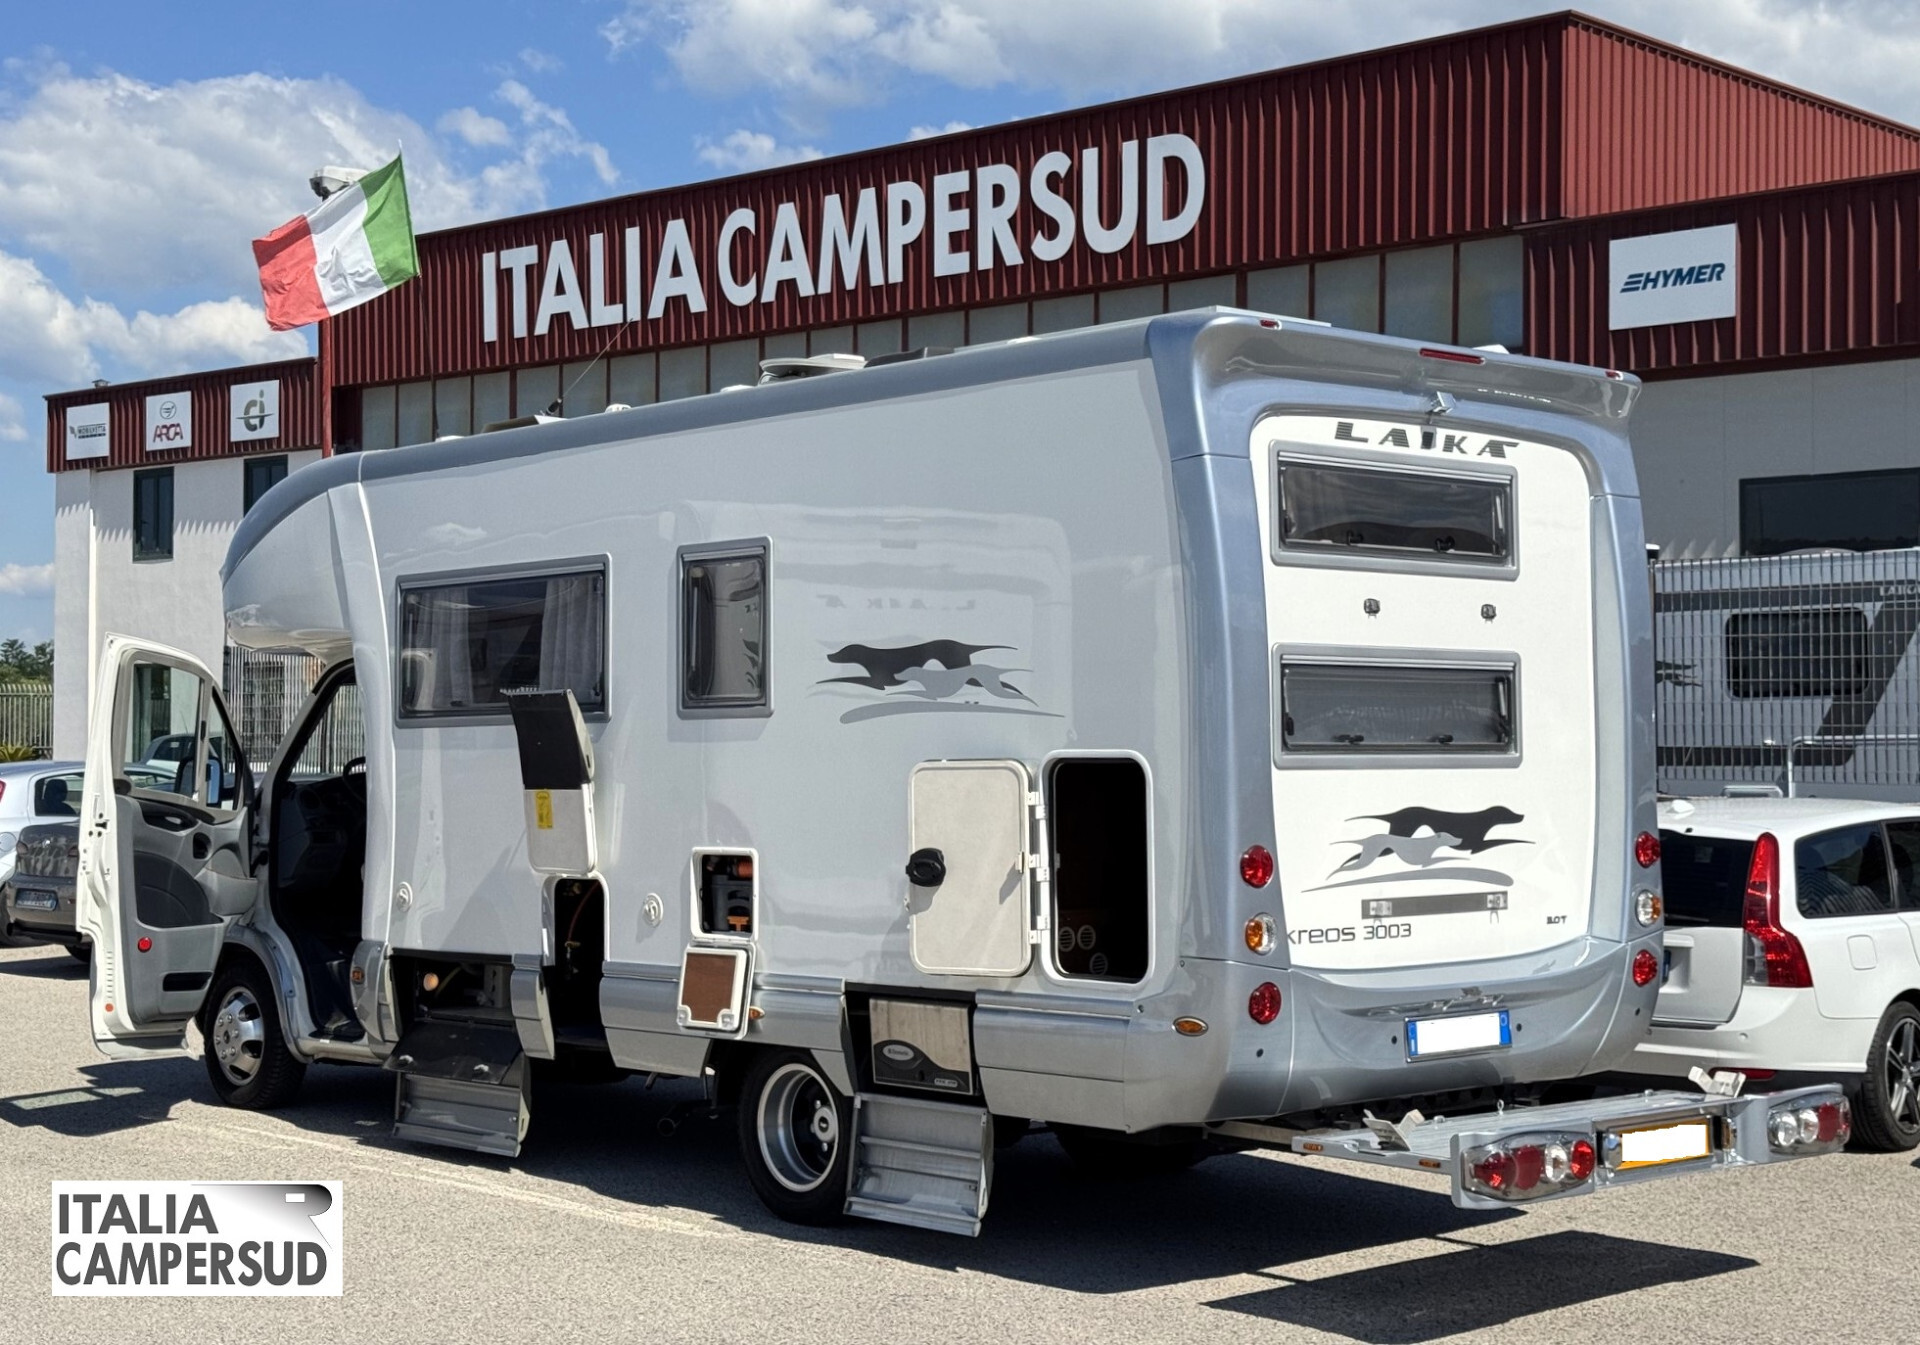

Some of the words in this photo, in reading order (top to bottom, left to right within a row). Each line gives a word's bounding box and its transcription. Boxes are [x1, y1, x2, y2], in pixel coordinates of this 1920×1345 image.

[482, 218, 707, 343] ITALIA
[717, 133, 1206, 306] CAMPERSUD
[153, 423, 184, 443] ARCA
[1335, 421, 1519, 458] LAIKA
[1362, 923, 1412, 941] 3003
